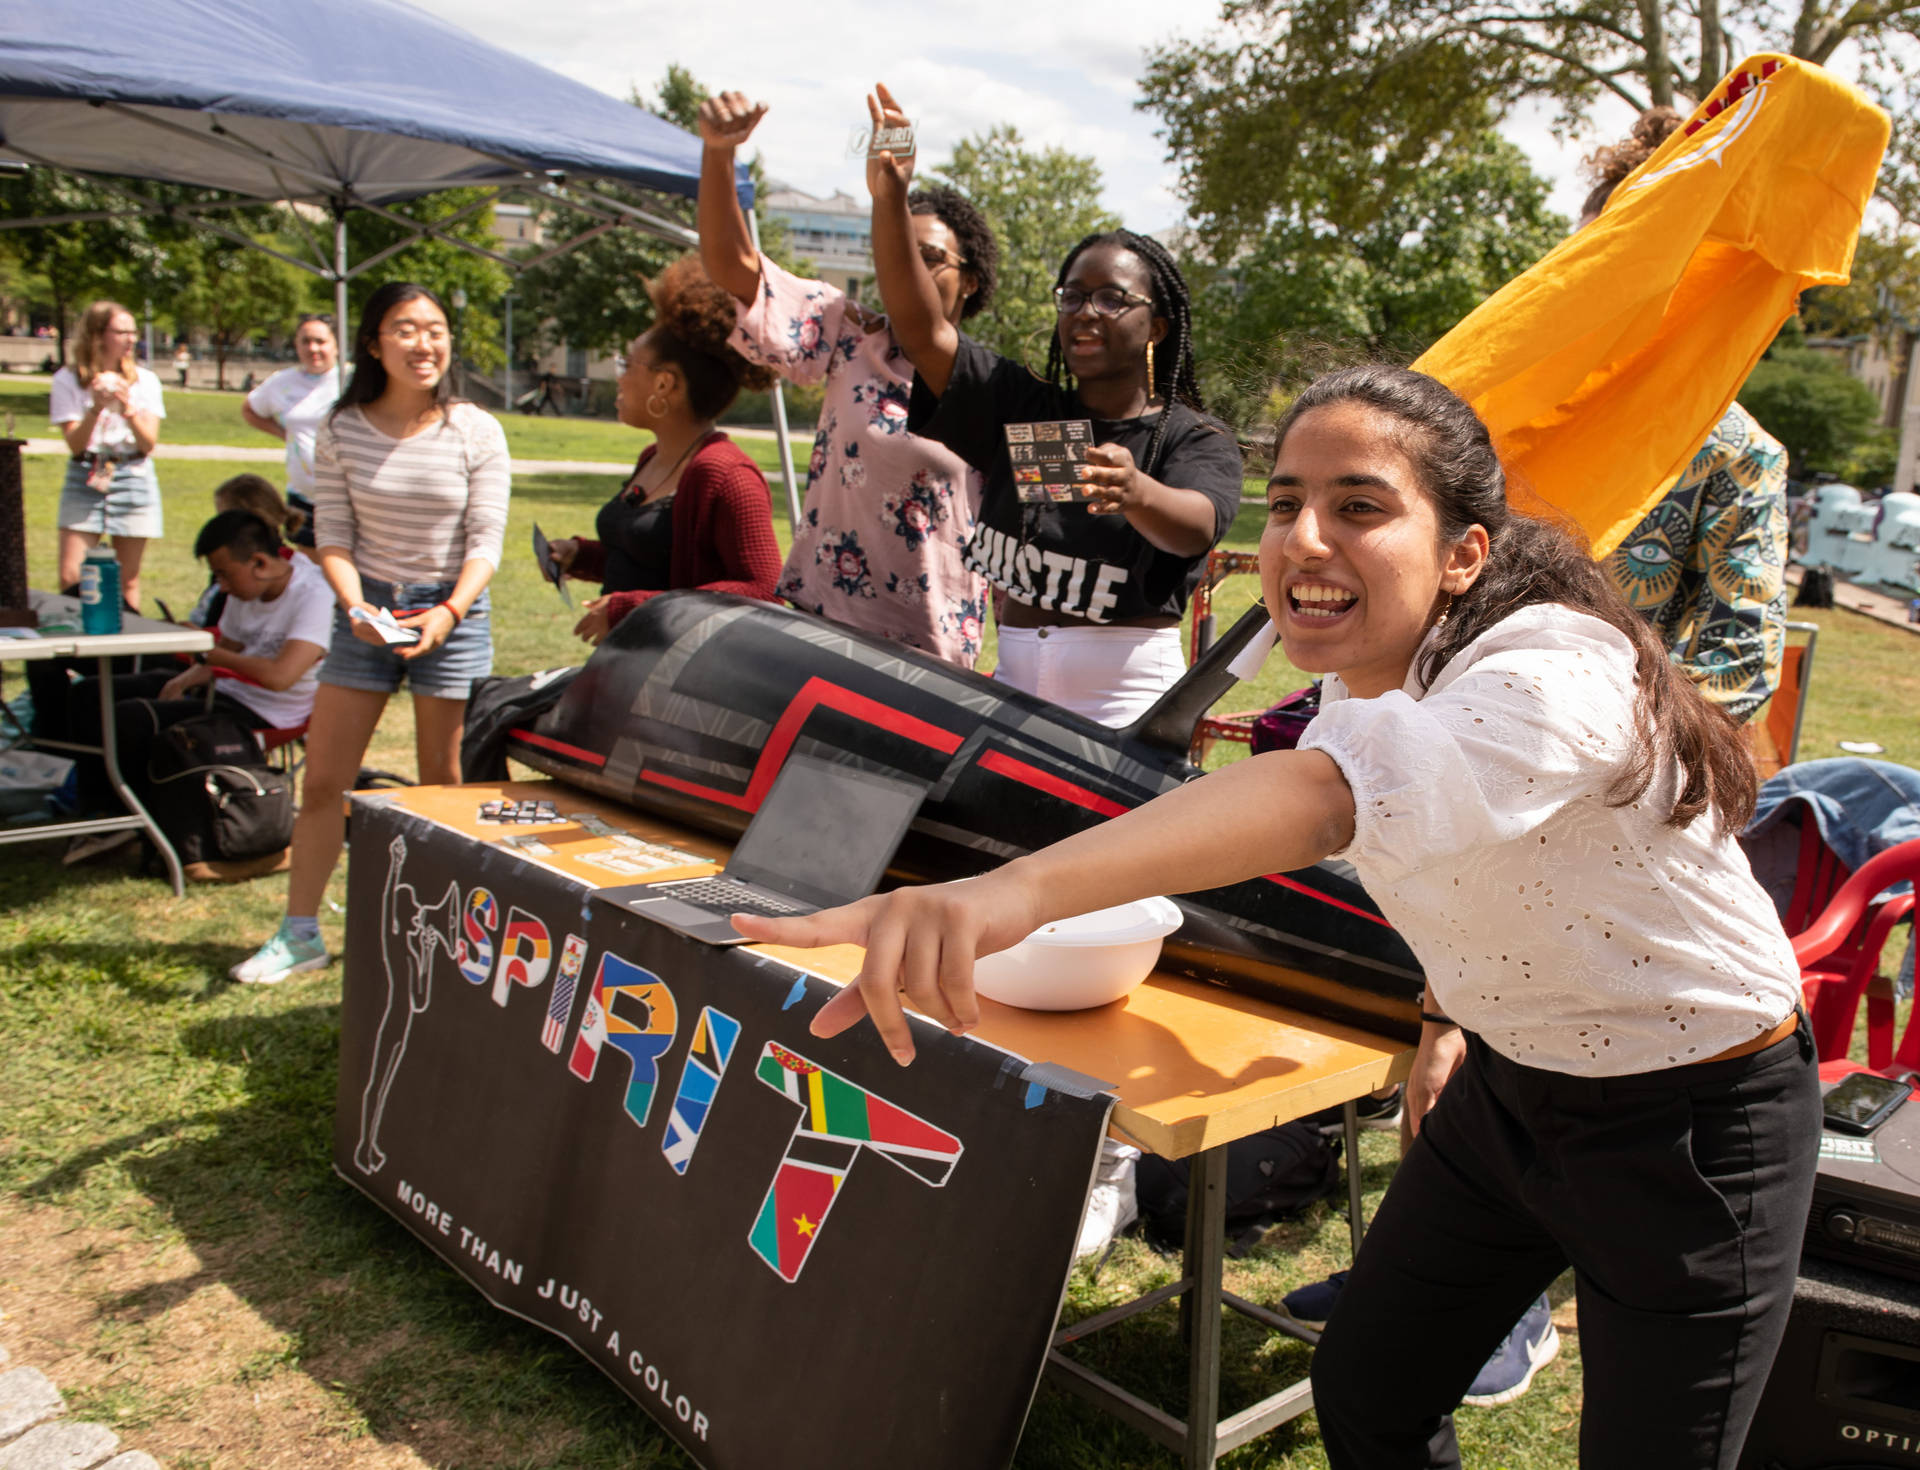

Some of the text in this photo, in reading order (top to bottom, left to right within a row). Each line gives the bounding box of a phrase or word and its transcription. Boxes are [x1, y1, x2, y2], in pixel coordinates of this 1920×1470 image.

[964, 521, 1129, 624] HUSTLE
[457, 886, 964, 1283] SPIRIT
[397, 1180, 710, 1442] MORE THAN JUST A COLOR
